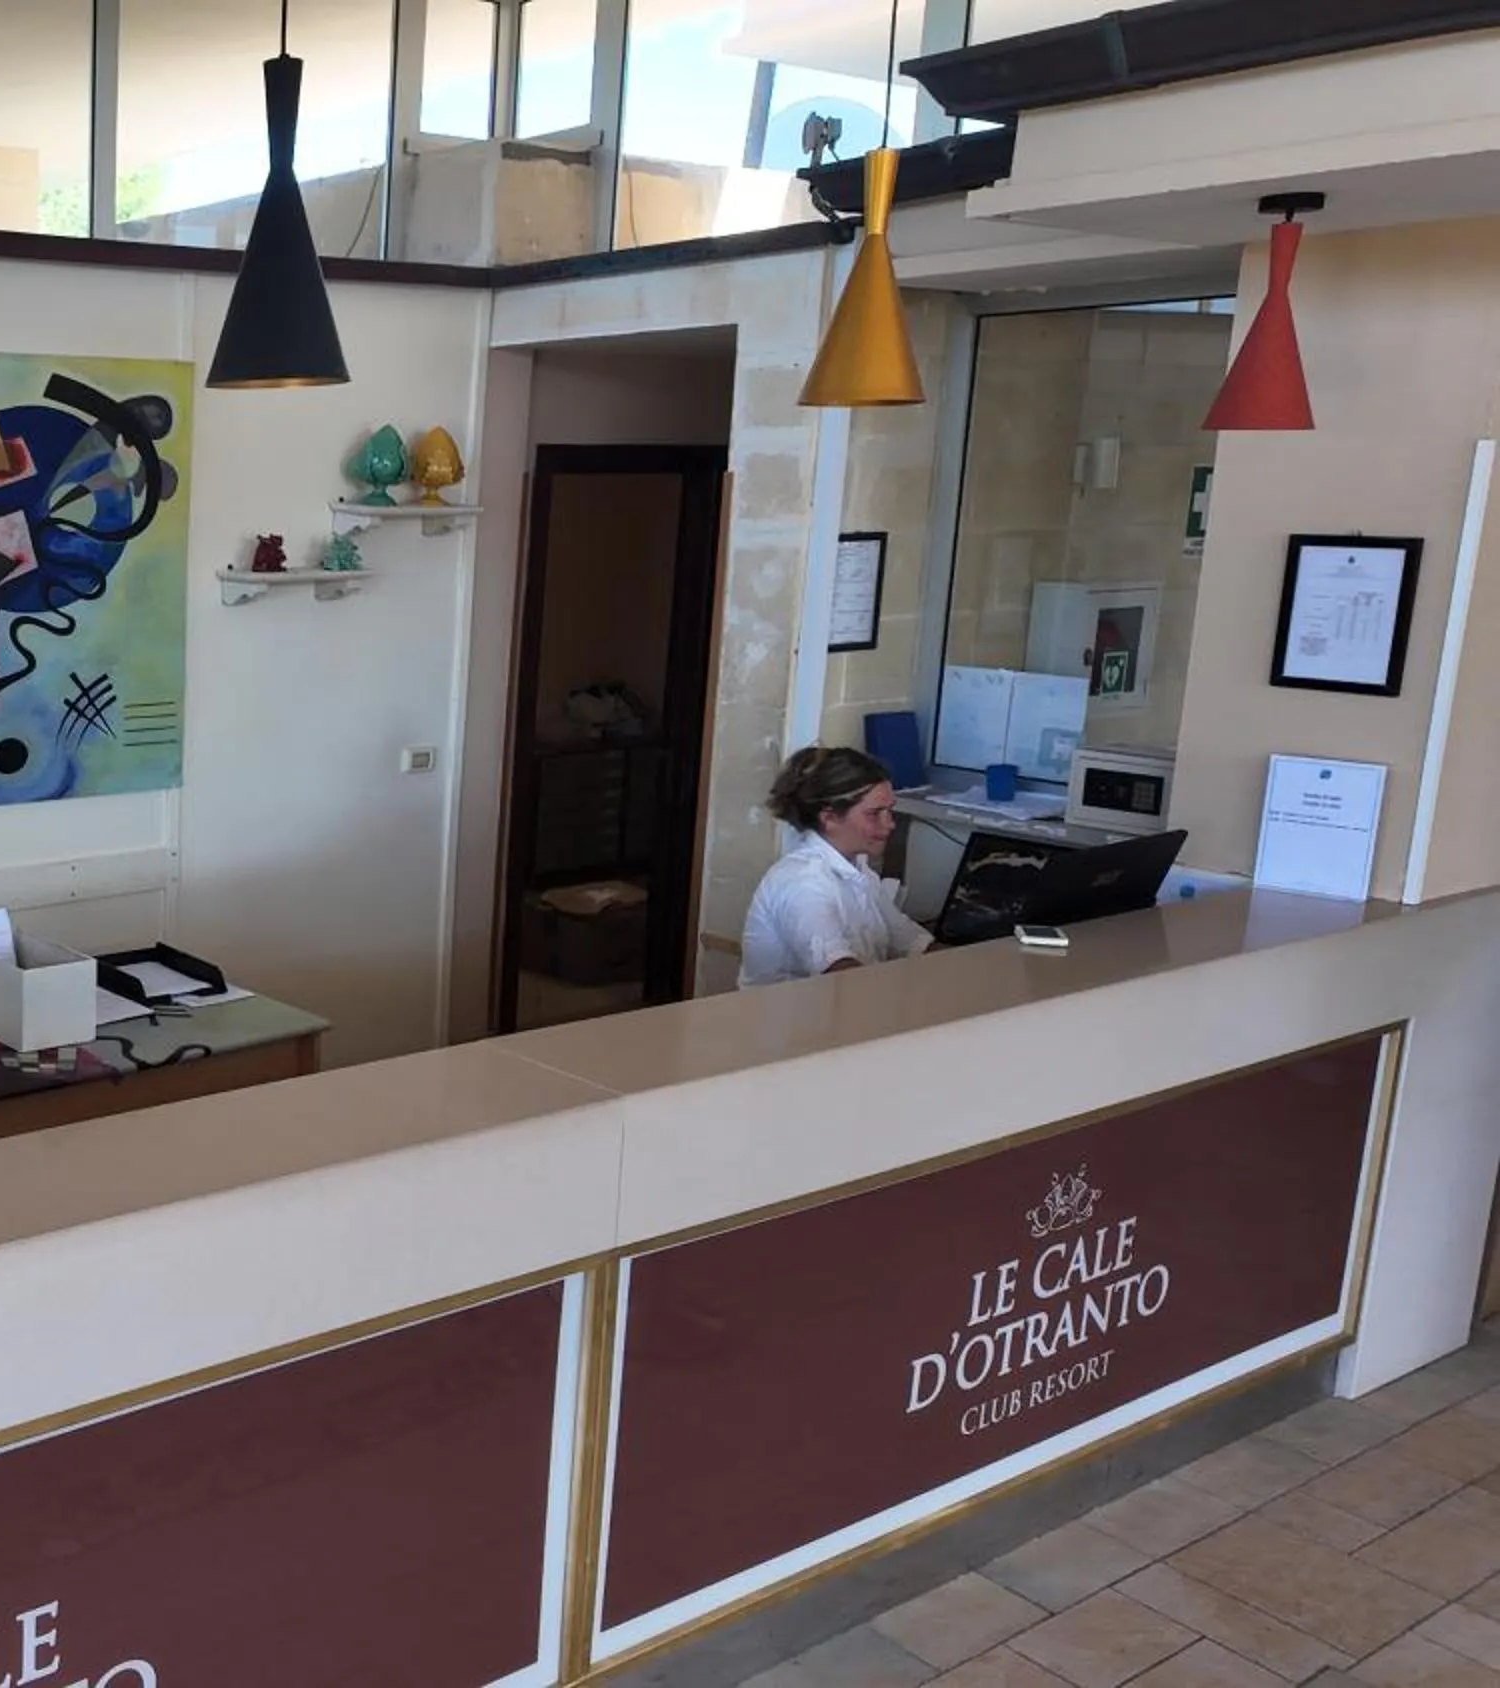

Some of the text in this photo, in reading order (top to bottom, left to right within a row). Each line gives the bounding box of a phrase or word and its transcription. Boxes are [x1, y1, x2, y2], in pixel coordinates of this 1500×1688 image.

[967, 1216, 1137, 1327] LE CALE
[906, 1264, 1170, 1413] D'OTRANTO
[960, 1350, 1115, 1436] CLUB RESORT
